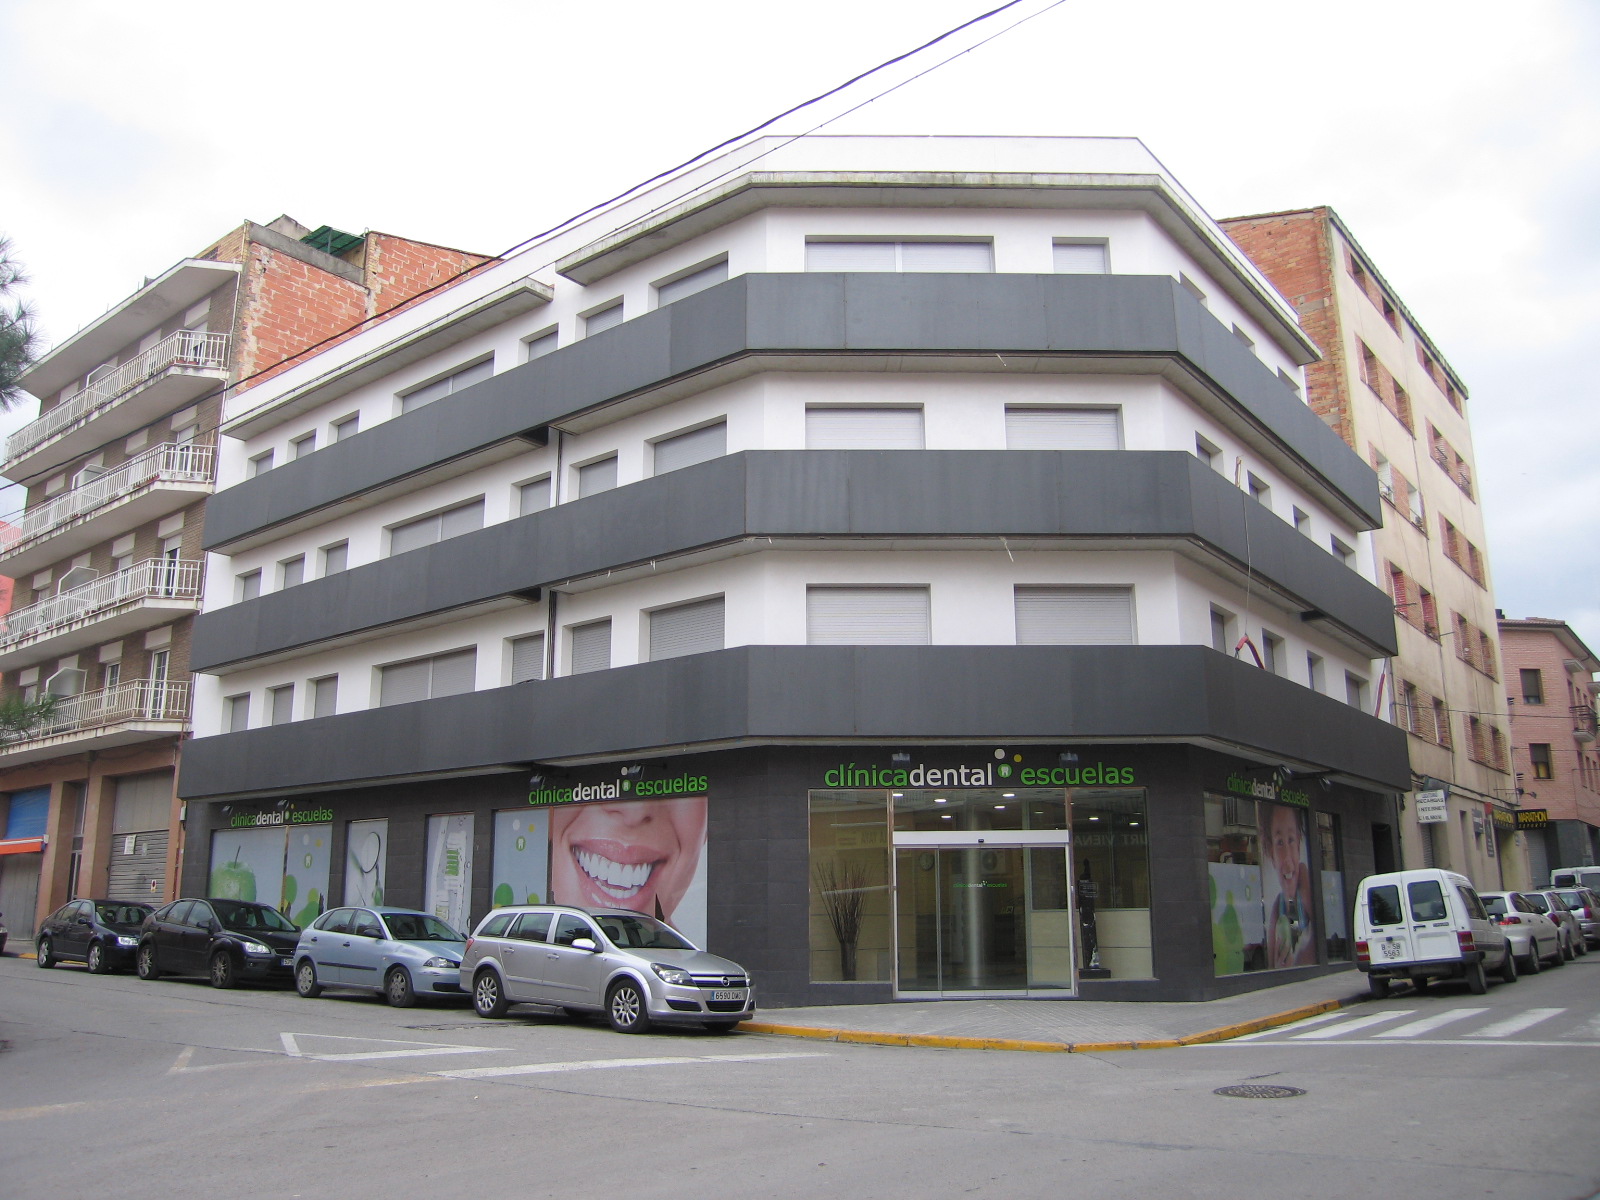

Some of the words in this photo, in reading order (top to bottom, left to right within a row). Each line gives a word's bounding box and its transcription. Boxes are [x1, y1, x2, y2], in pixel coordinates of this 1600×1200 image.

[824, 763, 992, 787] clínicadental
[1020, 762, 1135, 785] escuelas
[635, 773, 708, 796] escuelas
[1281, 789, 1310, 807] escuelas
[292, 806, 333, 823] escuelas
[1517, 811, 1547, 823] MARATHON
[715, 991, 731, 1000] 6590
